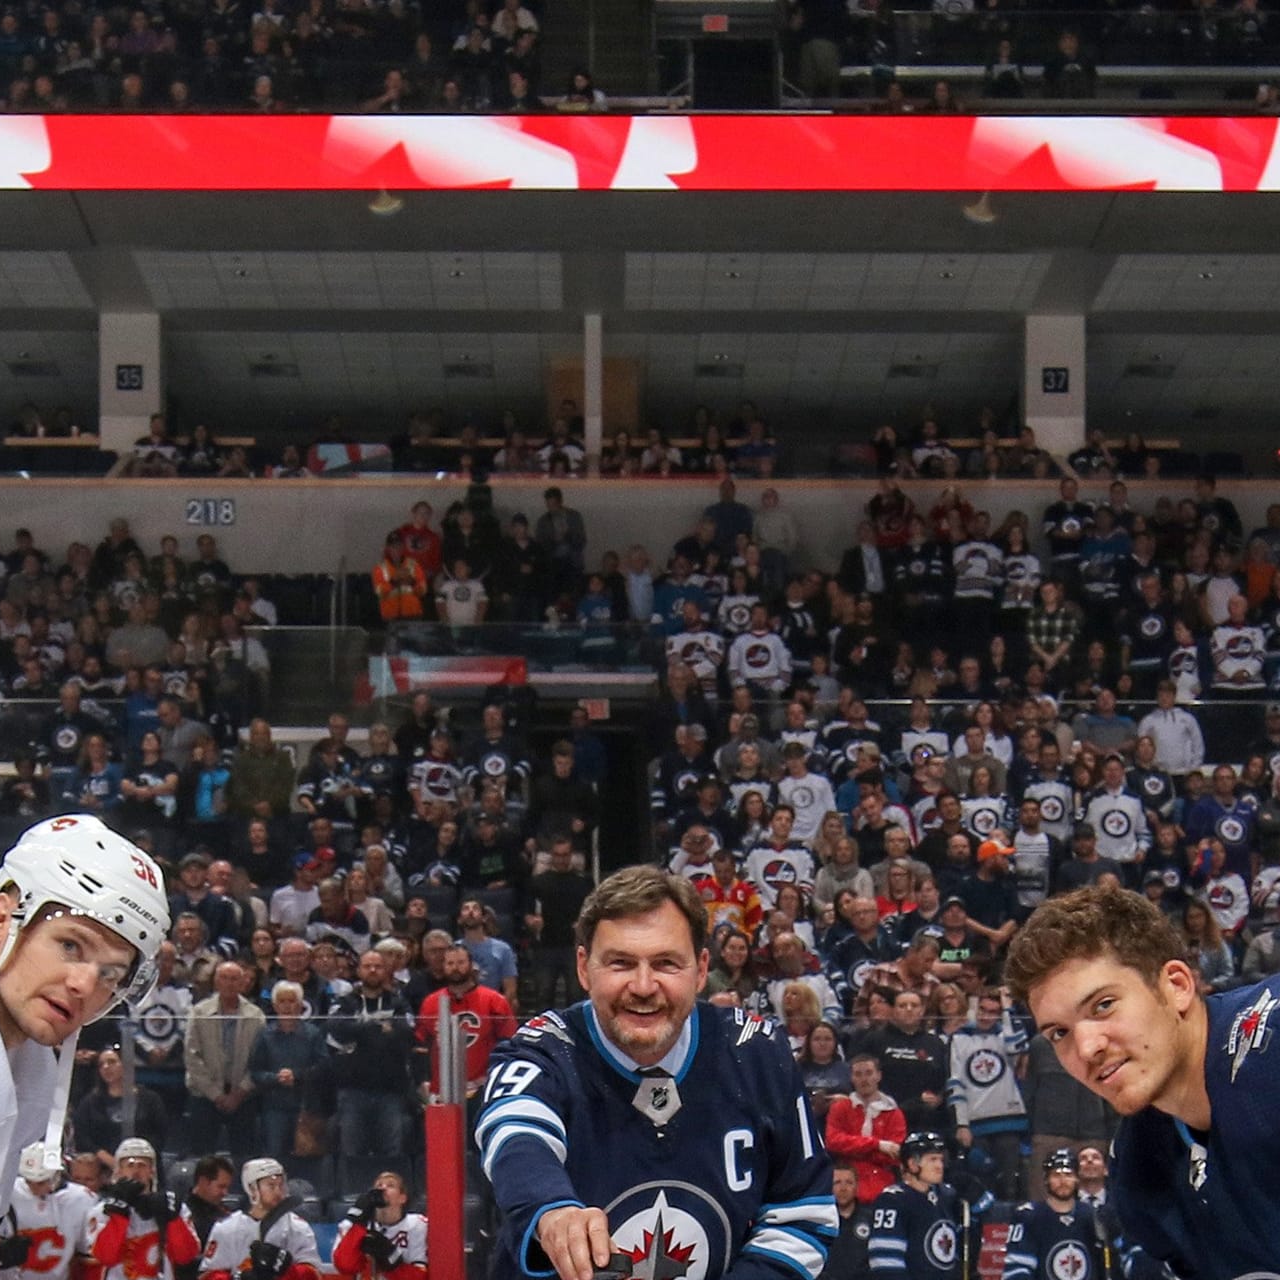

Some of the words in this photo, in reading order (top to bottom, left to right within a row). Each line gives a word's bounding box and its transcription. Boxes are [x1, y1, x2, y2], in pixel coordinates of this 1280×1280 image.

[119, 367, 141, 387] 35
[1045, 371, 1066, 391] 37
[185, 499, 235, 525] 218
[131, 855, 158, 889] 38
[484, 1060, 542, 1103] 19
[724, 1129, 754, 1192] C
[873, 1210, 897, 1229] 93
